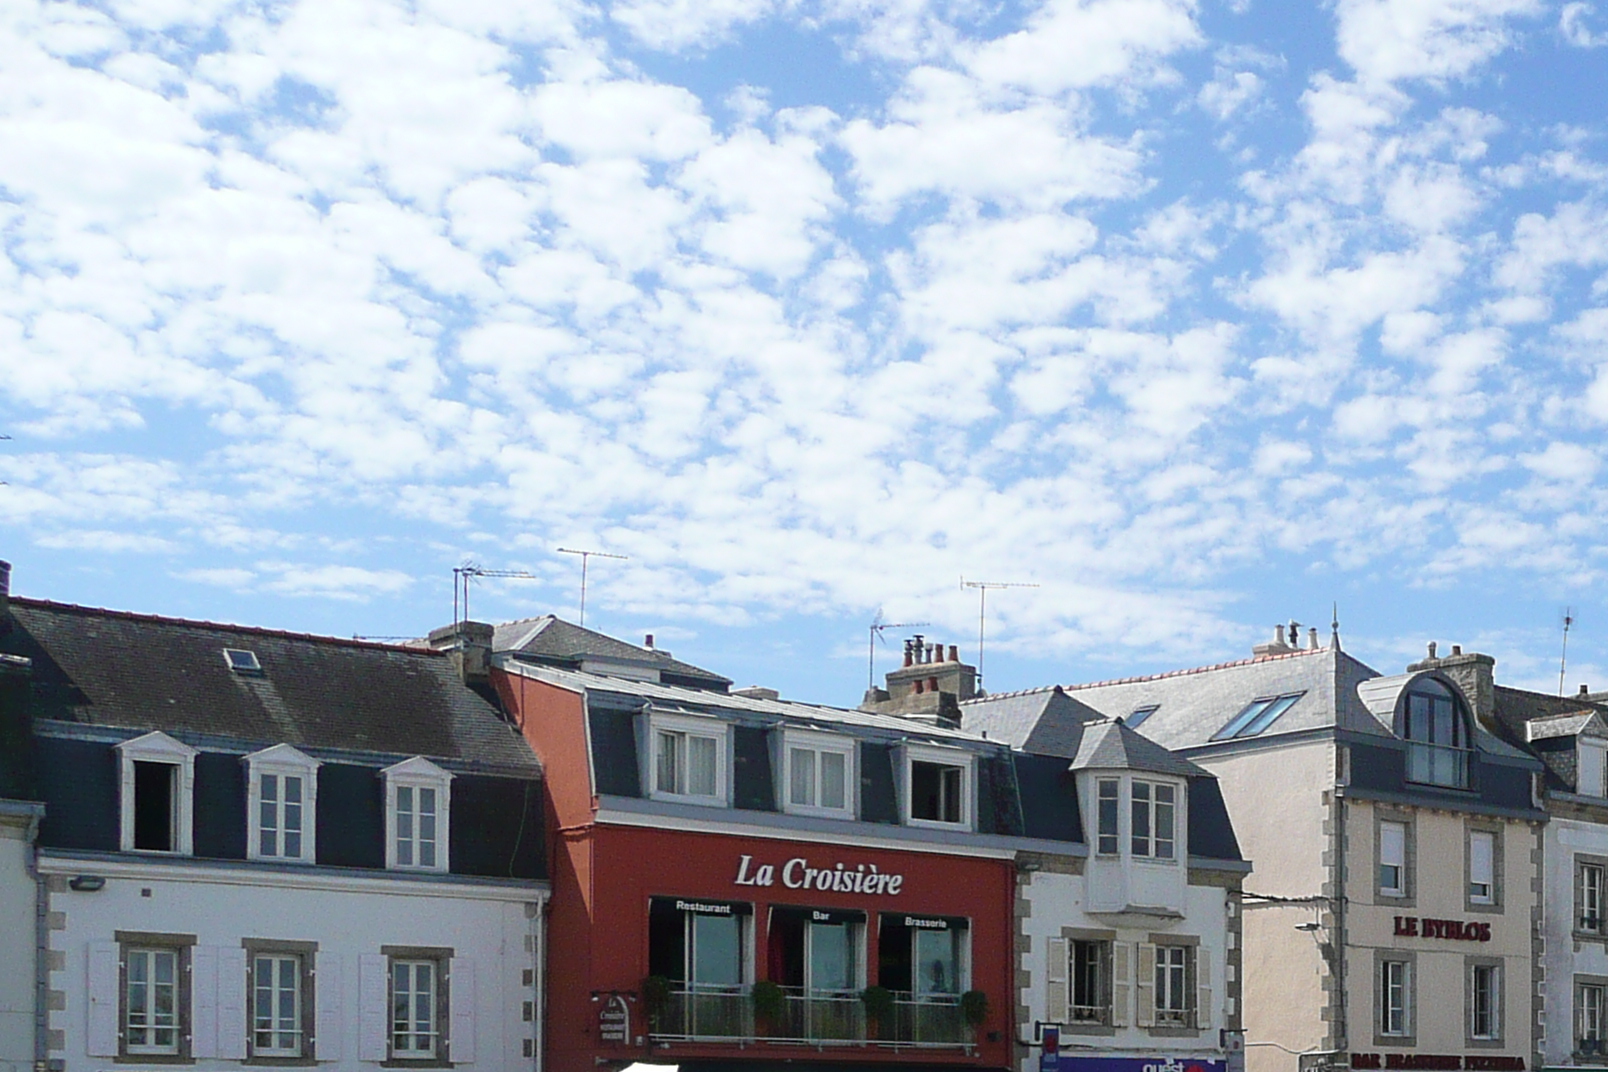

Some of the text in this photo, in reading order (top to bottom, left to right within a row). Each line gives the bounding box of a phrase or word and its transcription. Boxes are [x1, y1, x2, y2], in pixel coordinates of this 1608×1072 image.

[734, 854, 903, 895] La Croisière
[676, 900, 731, 914] Restaurant
[812, 910, 831, 921] Bar
[904, 916, 948, 929] Brasserie
[1393, 915, 1492, 942] LE BYBLOS
